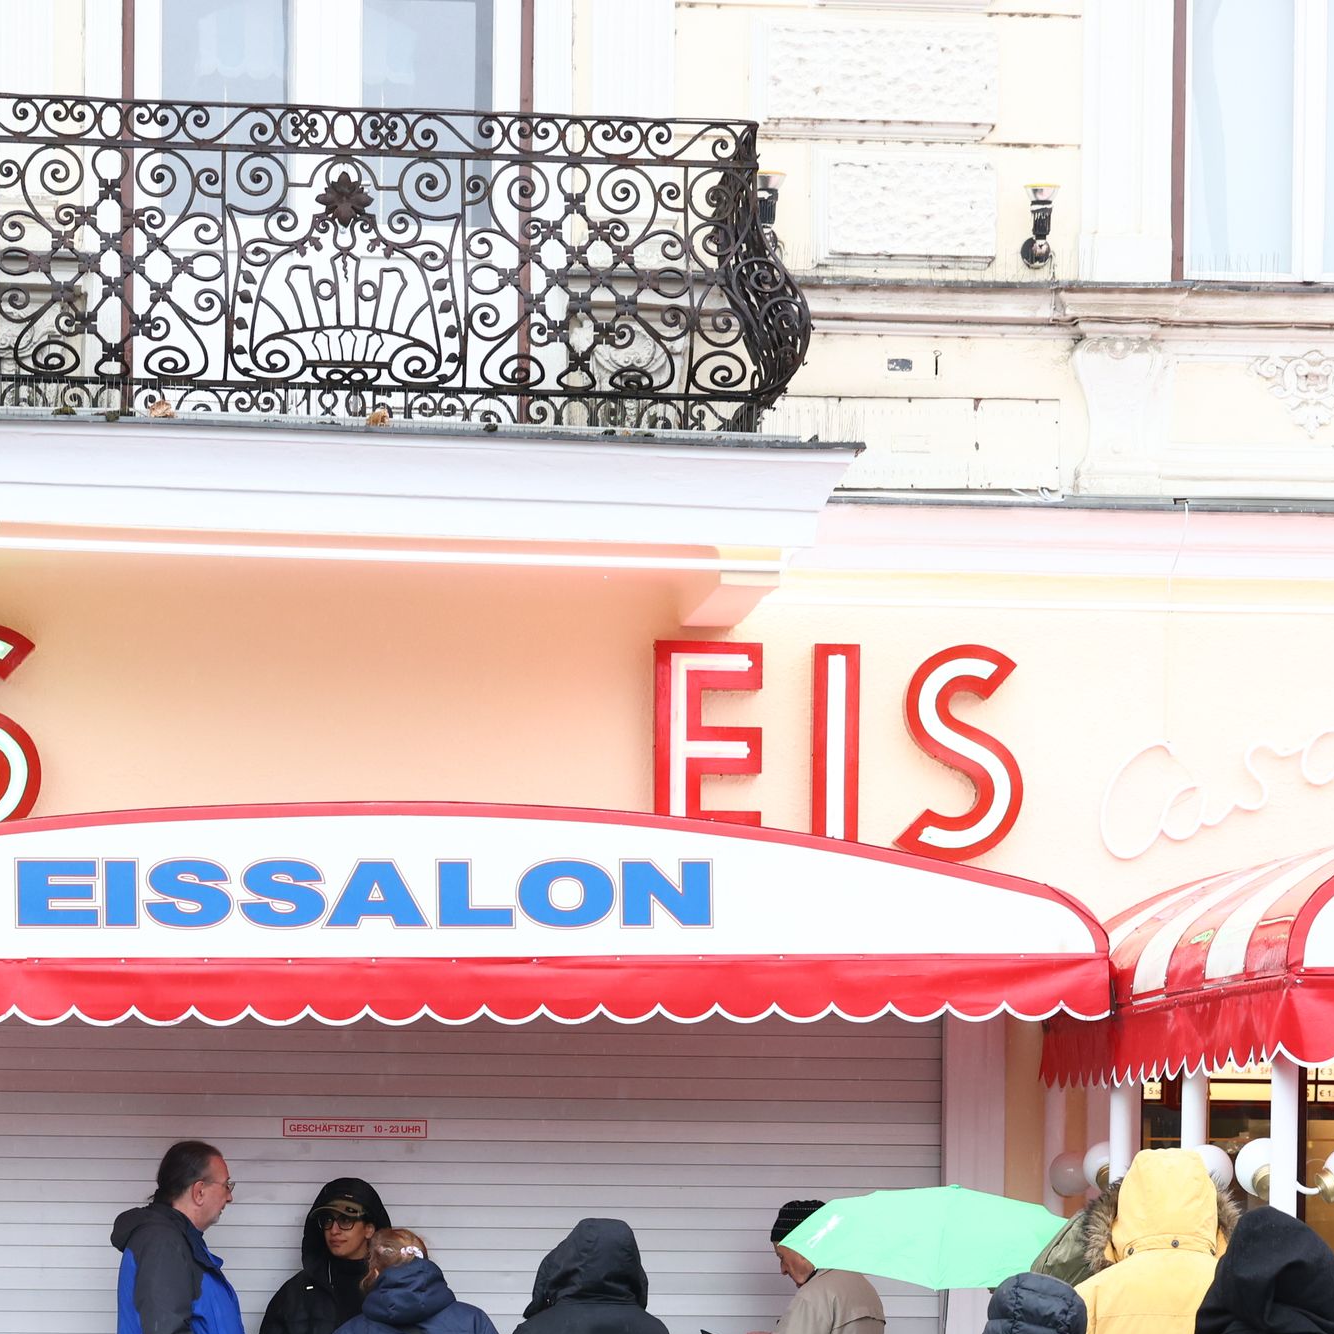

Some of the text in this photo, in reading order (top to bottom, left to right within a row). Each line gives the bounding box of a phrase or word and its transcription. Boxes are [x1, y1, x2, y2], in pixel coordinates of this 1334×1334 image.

[654, 640, 1024, 861] EIS
[15, 856, 715, 929] EISSALON
[289, 1122, 365, 1133] GESCHÄFTSZEIT
[373, 1125, 383, 1133] 10
[389, 1126, 400, 1134] 23
[400, 1126, 421, 1134] UHR
